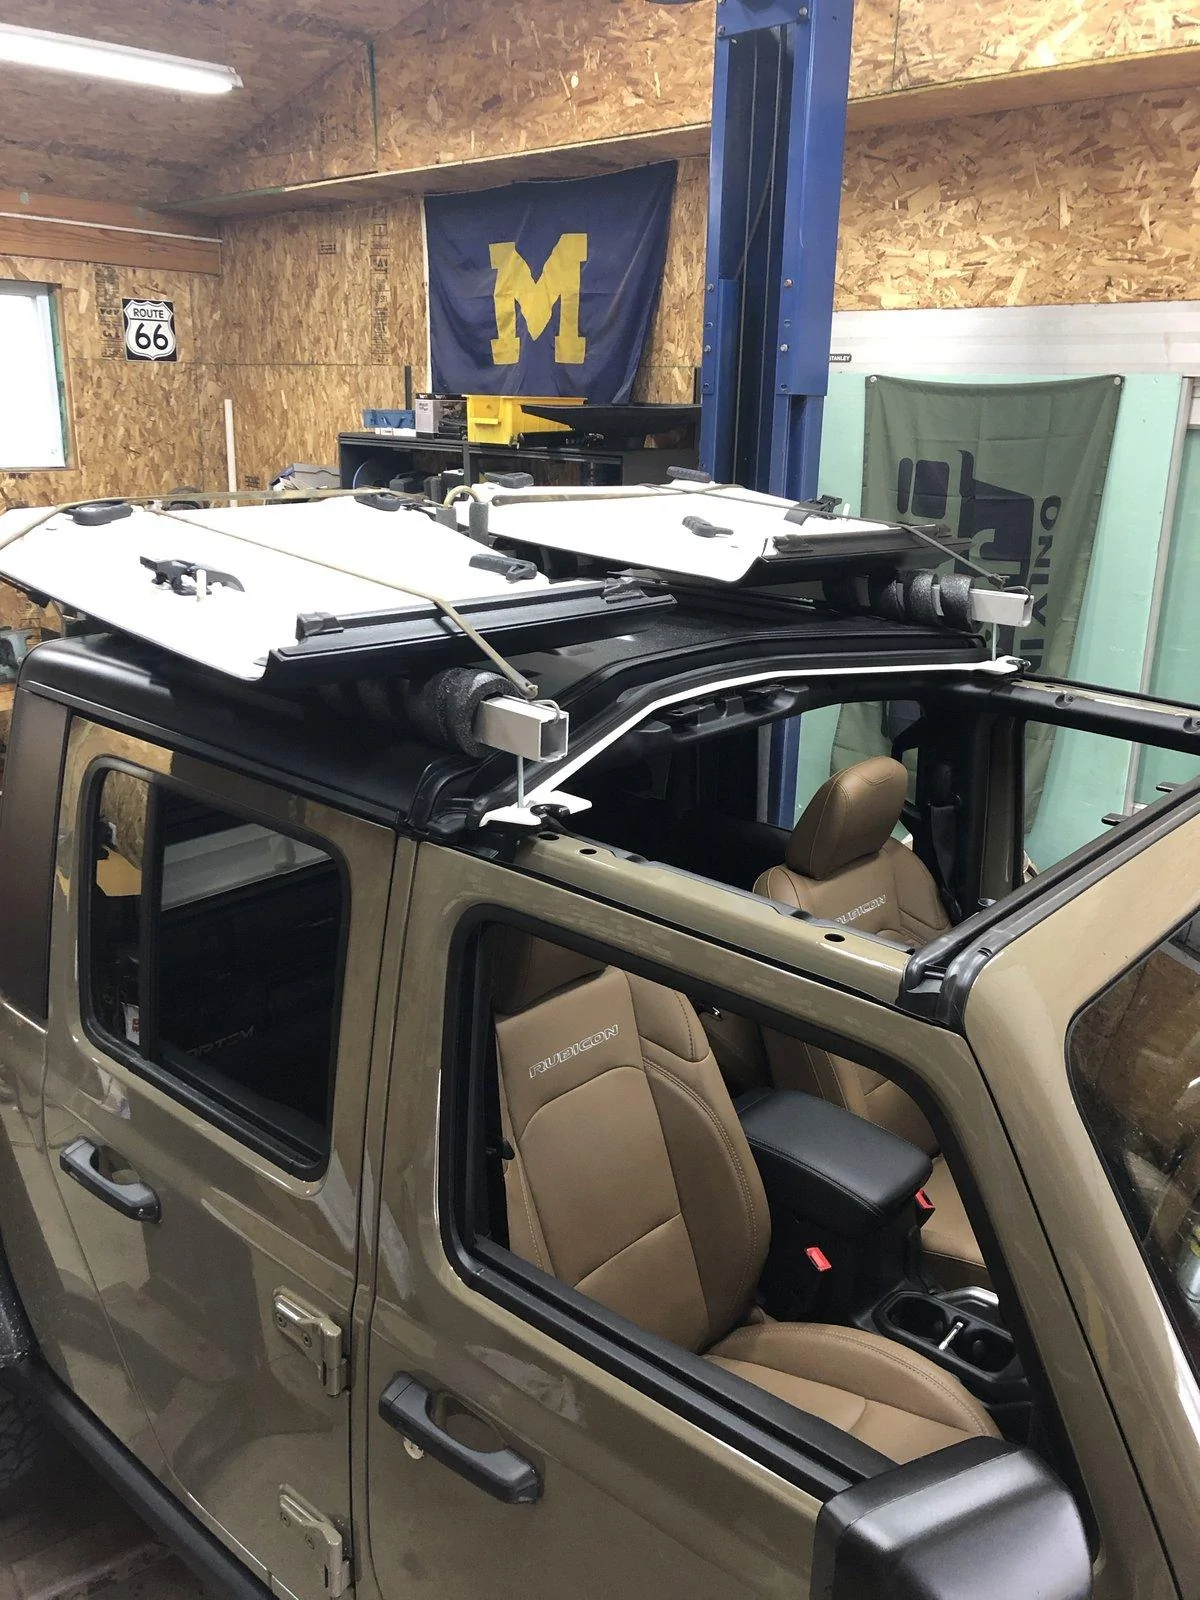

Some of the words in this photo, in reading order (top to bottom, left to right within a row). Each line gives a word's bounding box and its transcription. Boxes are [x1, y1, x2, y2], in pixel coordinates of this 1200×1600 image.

[133, 308, 164, 318] ROUTE
[489, 233, 587, 365] M
[135, 322, 169, 350] 66
[528, 1024, 619, 1078] RUBICON
